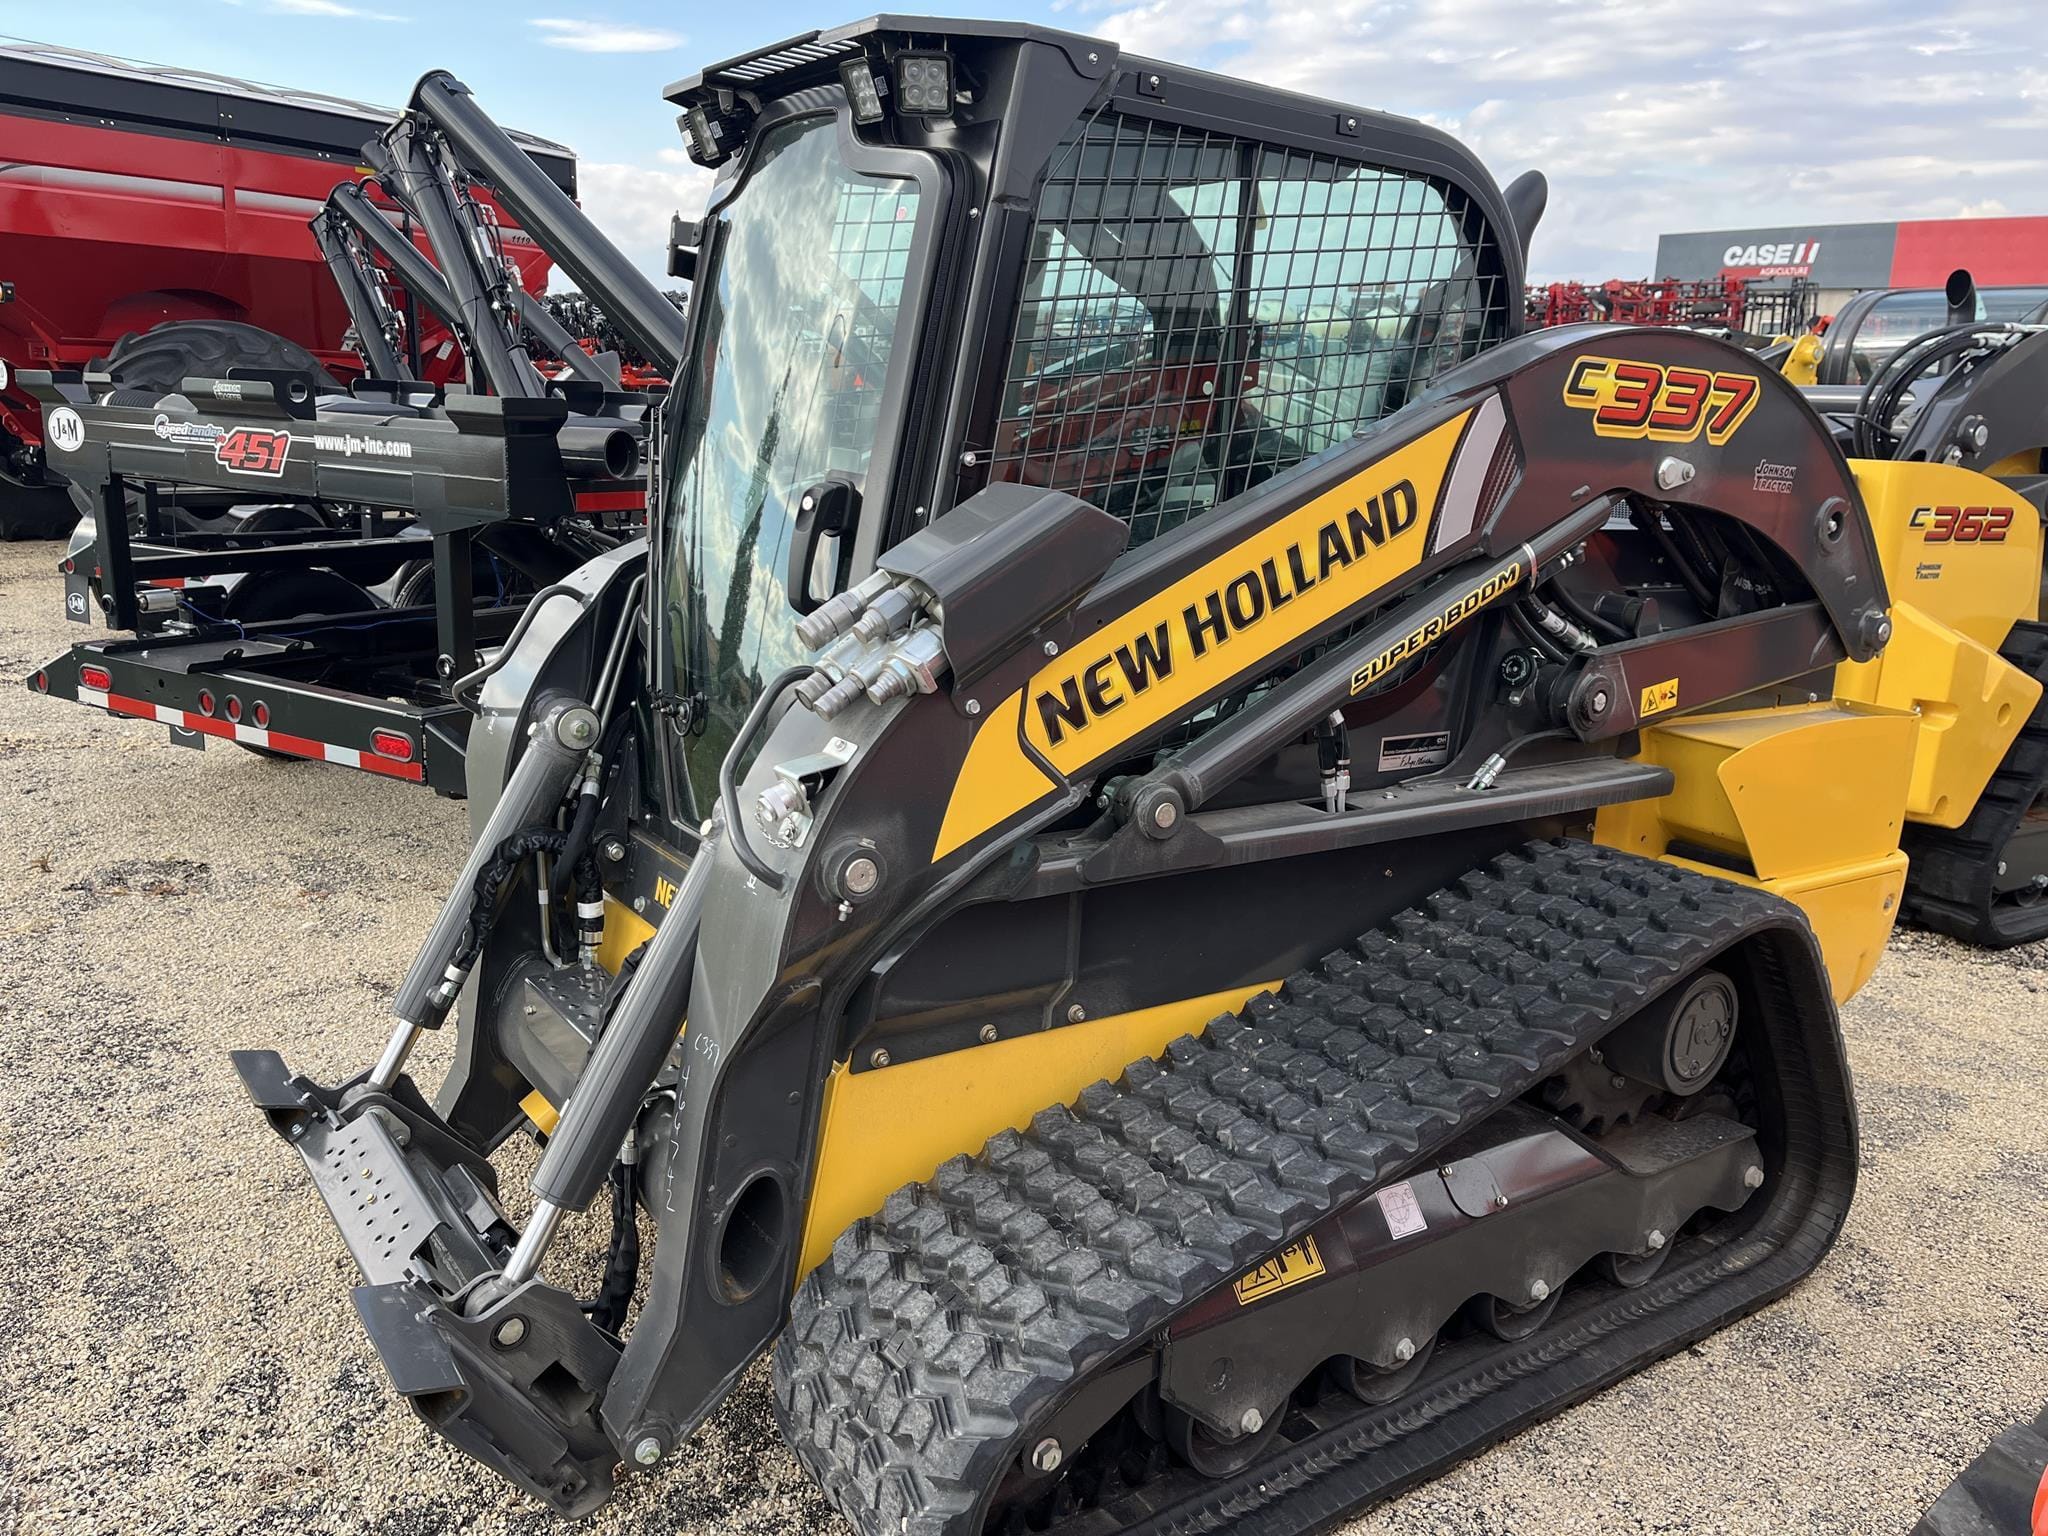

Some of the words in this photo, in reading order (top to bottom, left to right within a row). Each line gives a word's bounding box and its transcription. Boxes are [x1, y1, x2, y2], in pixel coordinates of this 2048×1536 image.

[1723, 244, 1794, 266] CASE
[1760, 267, 1808, 276] AGRICULTURE
[1565, 358, 1758, 438] C337
[53, 418, 79, 441] J&M
[218, 431, 288, 472] 451
[313, 433, 412, 457] www.jm-inc.com
[1755, 459, 1797, 478] JOHNSON
[1753, 476, 1793, 493] TRACTOR
[1909, 506, 2014, 543] C362
[1036, 619, 1174, 748] NEW
[1181, 479, 1419, 660] HOLLAND
[1350, 616, 1443, 696] SUPER
[1443, 562, 1521, 632] BOOM
[655, 876, 679, 909] NE
